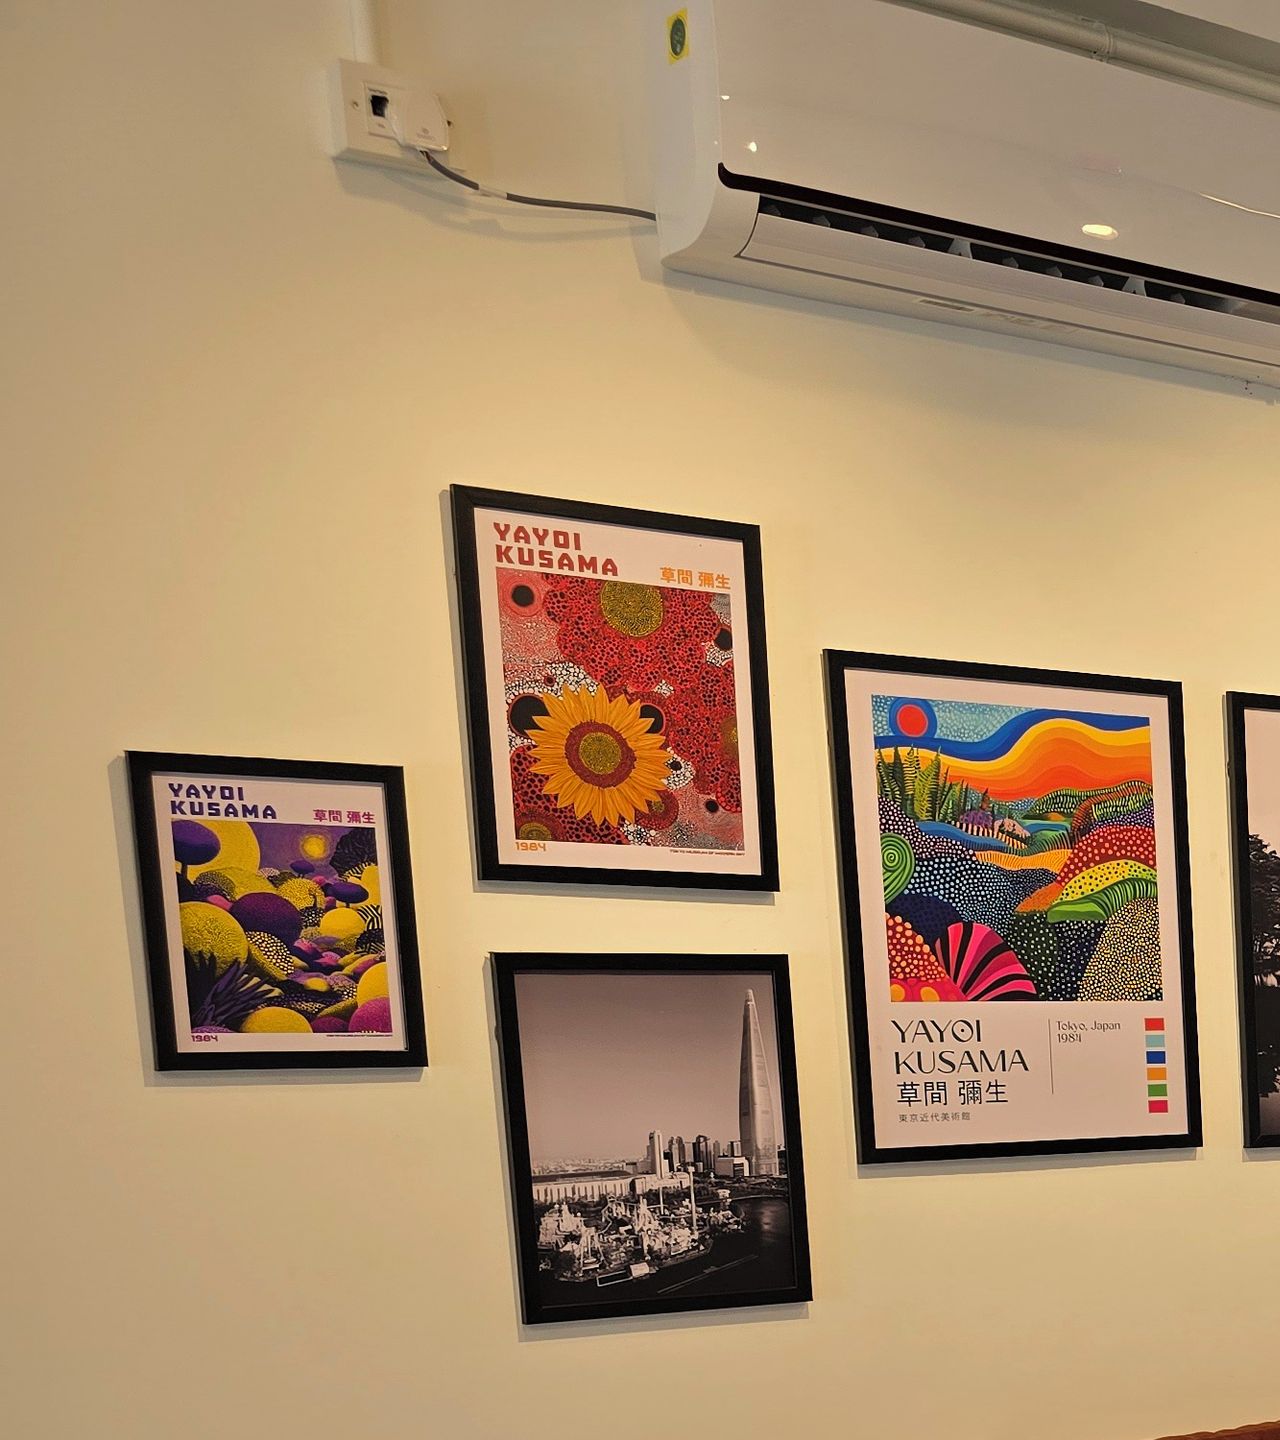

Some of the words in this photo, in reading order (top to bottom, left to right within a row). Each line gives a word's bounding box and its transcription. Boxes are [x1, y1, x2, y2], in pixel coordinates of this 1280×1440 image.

[493, 522, 582, 551] YAYOI
[496, 544, 619, 577] KUSAMA
[660, 566, 693, 586] 草間
[168, 783, 244, 801] YAYOI
[170, 800, 277, 819] KUSAMA
[515, 841, 547, 852] 1984
[891, 1019, 982, 1043] YAYOI
[1056, 1020, 1088, 1033] Tokyo,
[1091, 1020, 1121, 1033] Japan
[191, 1034, 218, 1043] 1984
[1057, 1033, 1082, 1043] 1984
[895, 1049, 1029, 1075] KUSAMA
[897, 1081, 948, 1107] 草間
[958, 1079, 1008, 1106] 彌生
